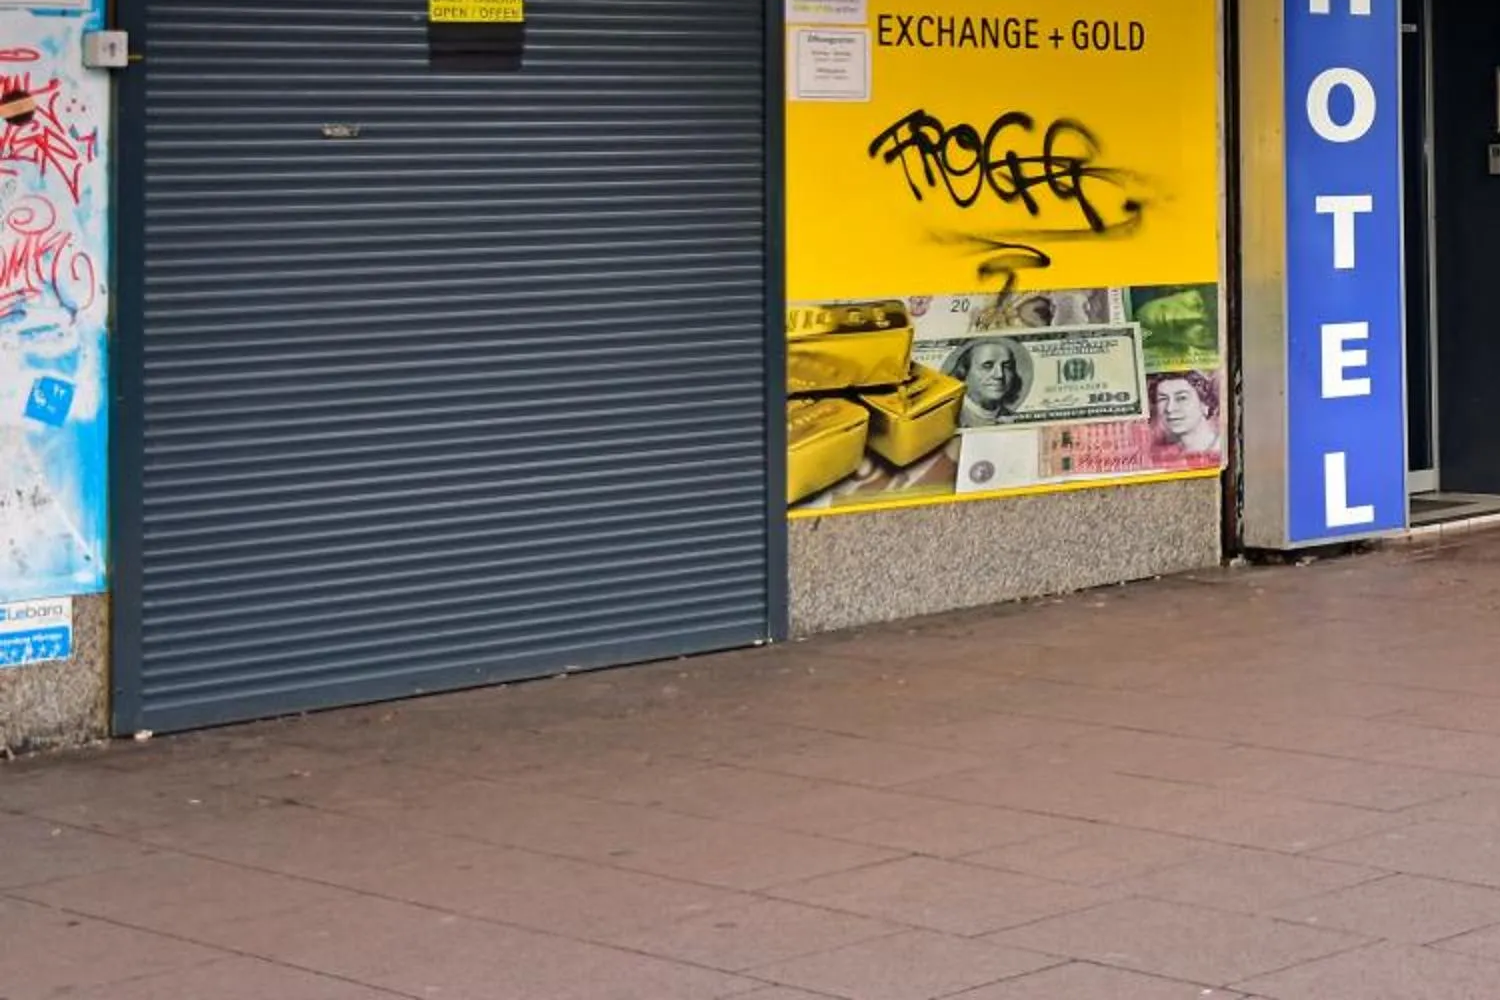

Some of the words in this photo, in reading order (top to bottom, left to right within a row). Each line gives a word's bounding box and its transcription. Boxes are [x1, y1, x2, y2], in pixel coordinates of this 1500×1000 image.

[877, 14, 1040, 49] EXCHANGE
[1049, 27, 1065, 49] +
[1072, 19, 1146, 51] GOLD
